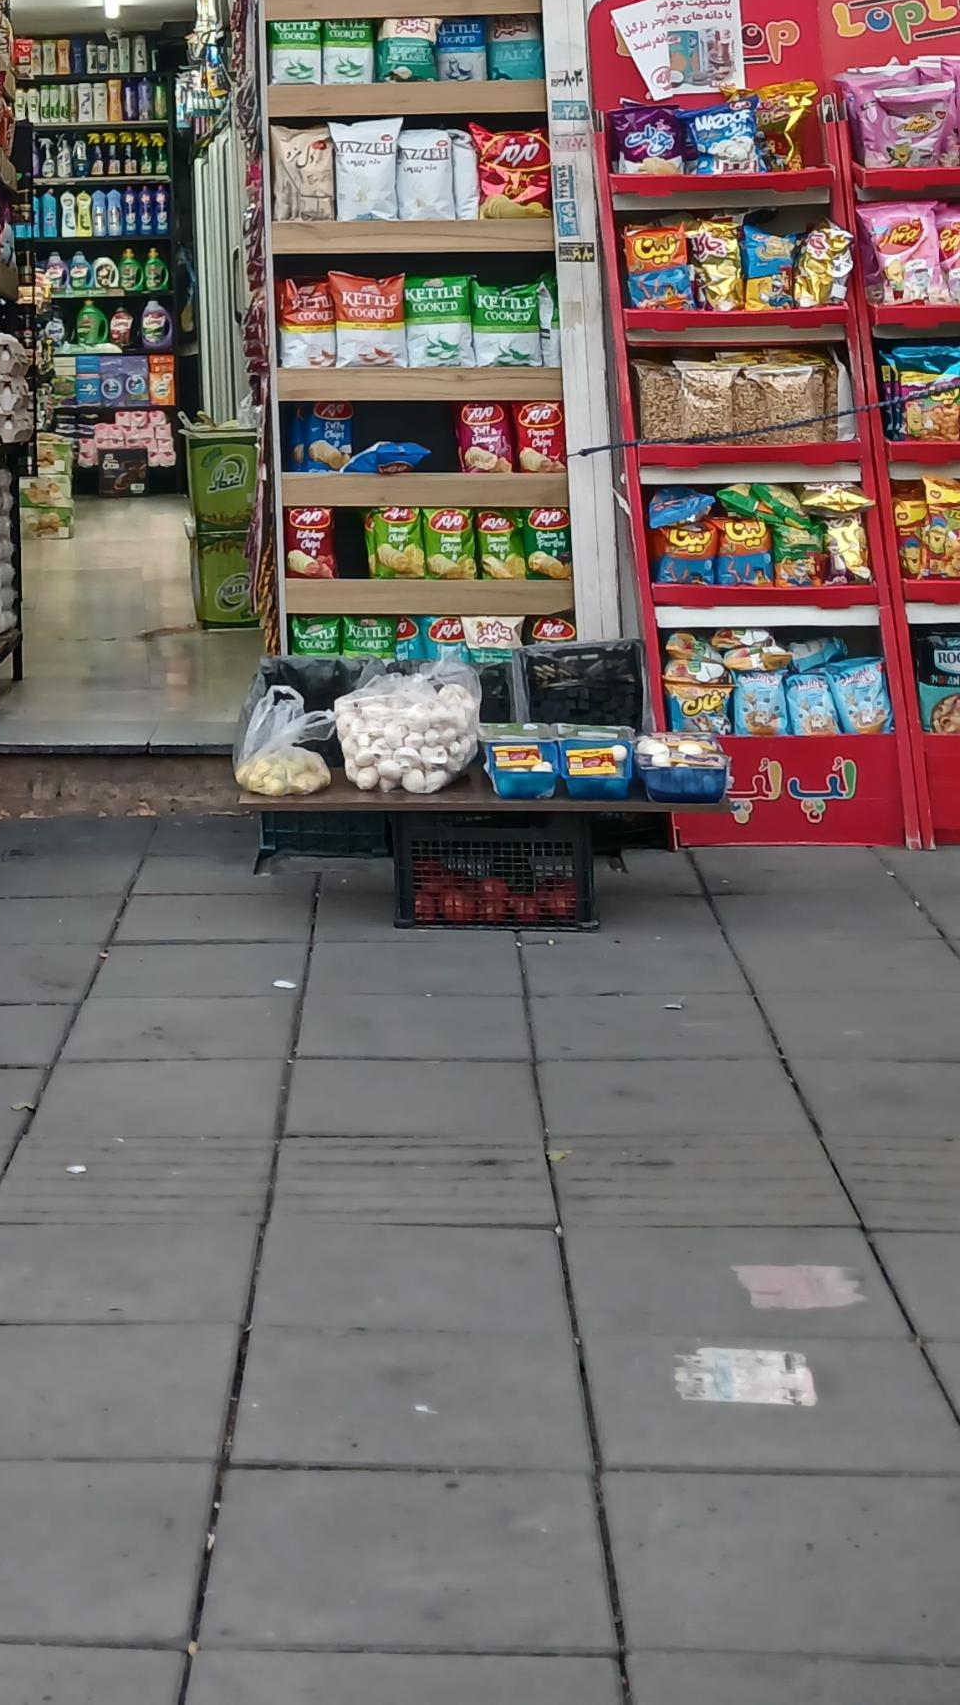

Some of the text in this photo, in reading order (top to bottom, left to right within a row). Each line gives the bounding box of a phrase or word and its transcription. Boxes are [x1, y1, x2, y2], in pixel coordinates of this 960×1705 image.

[329, 30, 365, 39] COOKED
[341, 291, 399, 307] KETTLE
[405, 285, 465, 302] KETTLE
[412, 301, 458, 313] COOKED
[476, 294, 537, 310] KETTLE
[348, 308, 395, 320] COOKED
[484, 310, 532, 322] COOKED
[348, 624, 393, 638] KETTLE
